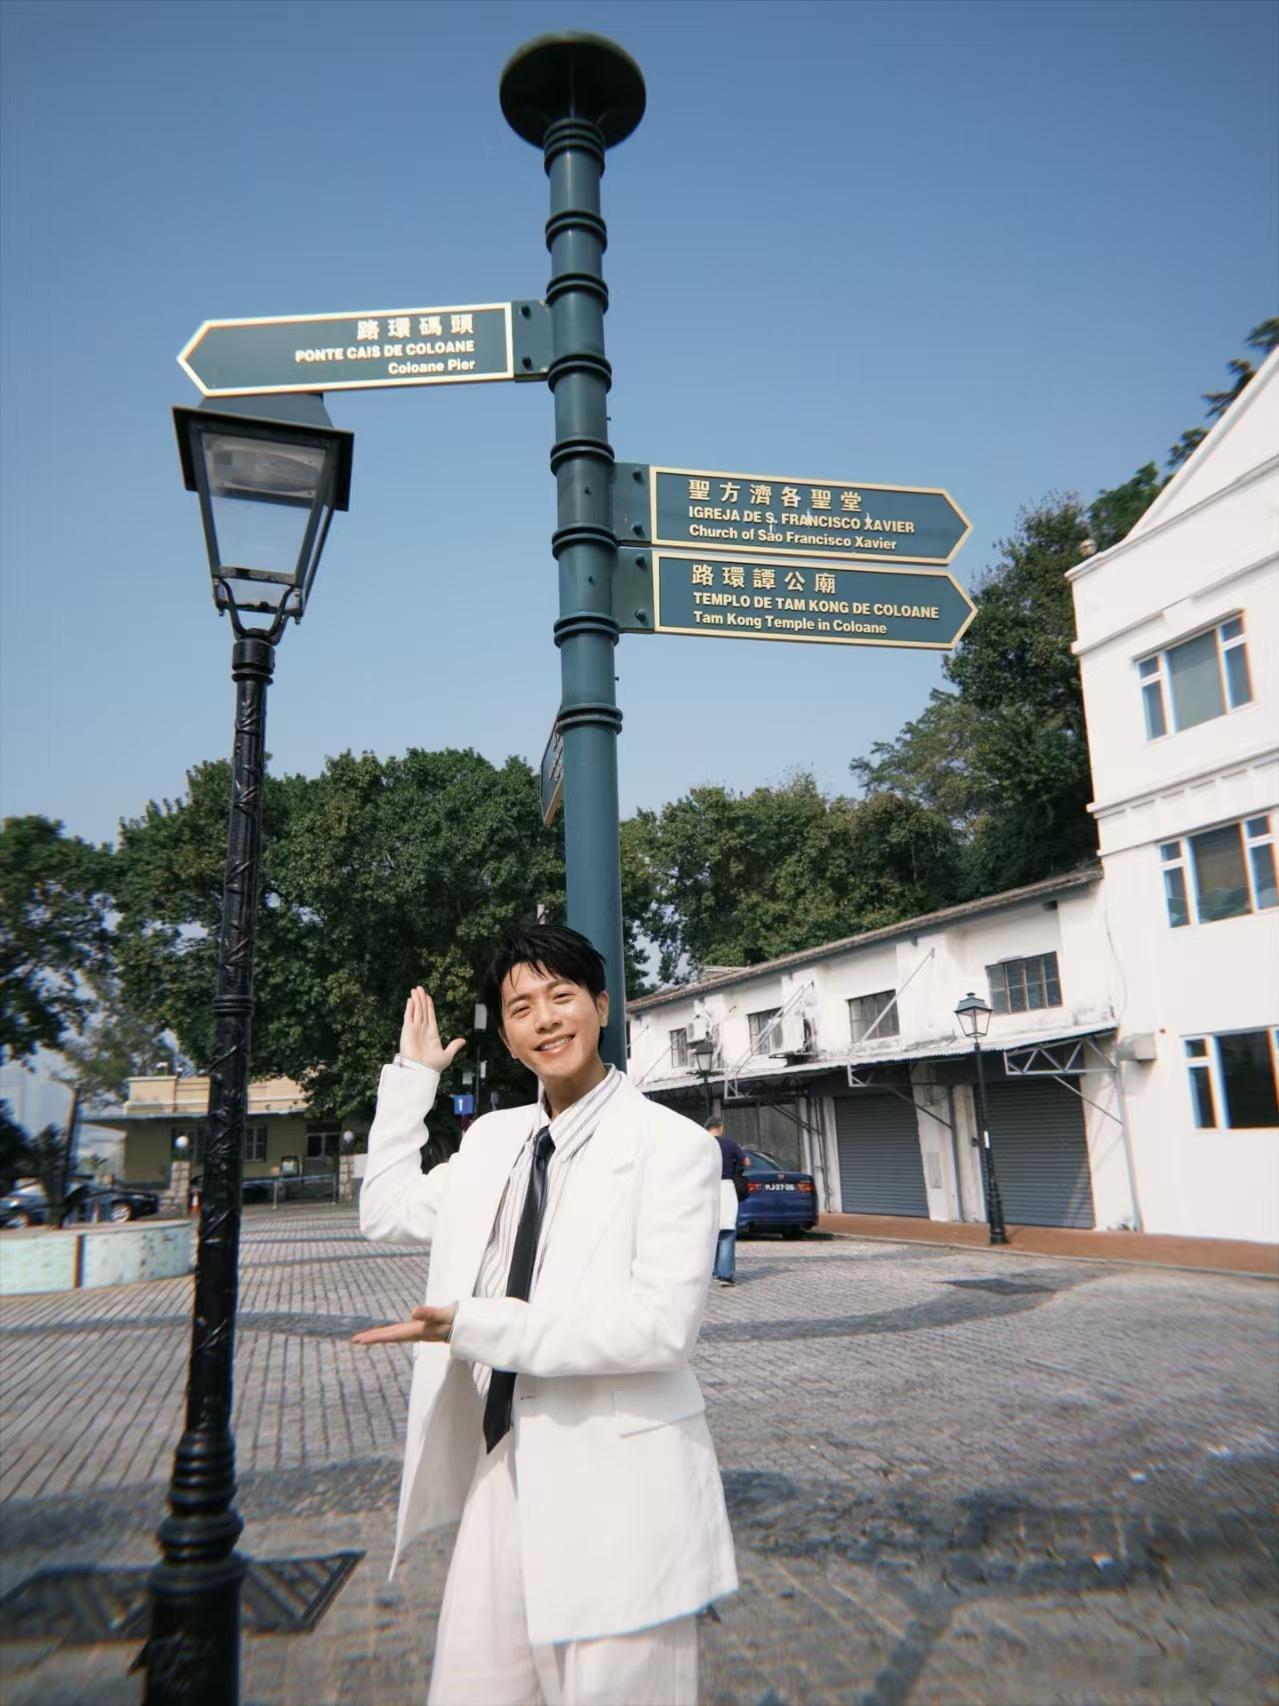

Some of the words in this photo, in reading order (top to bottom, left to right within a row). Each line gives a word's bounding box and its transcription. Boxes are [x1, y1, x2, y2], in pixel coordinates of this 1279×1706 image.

[356, 314, 474, 341] 路環碼頭
[295, 348, 344, 363] PONTE
[346, 345, 381, 360] CAIS
[384, 344, 403, 357] DE
[405, 340, 475, 356] COLOANE
[388, 361, 445, 375] Coloane
[448, 358, 475, 371] Pier
[688, 479, 863, 513] 聖方濟各聖堂
[689, 506, 740, 522] IGREJA
[744, 510, 762, 524] DE
[766, 512, 778, 525] S.
[781, 513, 861, 531] FRANCISCO
[864, 518, 915, 534] XAVIER
[689, 524, 740, 539] Church
[741, 528, 755, 541] of
[786, 531, 852, 548] Francisco
[853, 535, 897, 550] Xavier
[691, 564, 837, 595] 路環譚公廟
[693, 592, 751, 608] TEMPLO
[753, 596, 773, 609] DE
[776, 597, 805, 611] TAM
[808, 599, 849, 614] KONG
[852, 602, 871, 616] DE
[873, 603, 940, 619] COLOANE
[693, 610, 724, 625] Tam
[726, 613, 762, 629] Kong
[765, 615, 815, 631] Temple
[818, 618, 830, 631] in
[832, 619, 888, 634] Coloane
